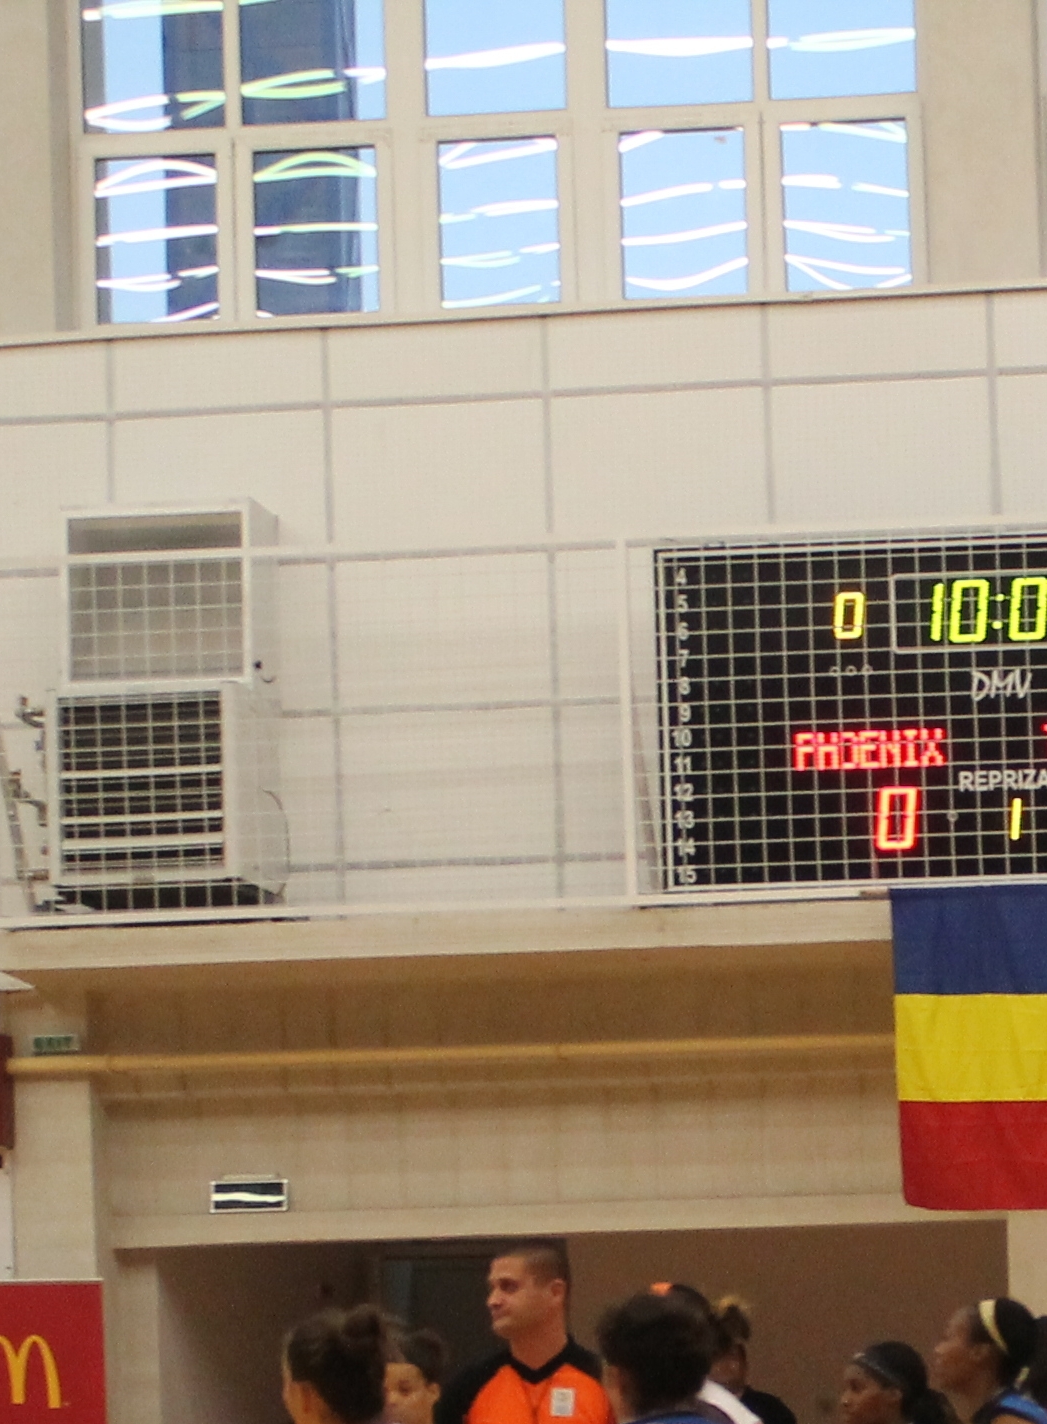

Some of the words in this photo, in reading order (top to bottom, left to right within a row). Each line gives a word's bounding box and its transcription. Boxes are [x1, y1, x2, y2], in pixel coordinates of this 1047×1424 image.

[676, 567, 687, 585] 4
[677, 593, 688, 613] 5
[833, 591, 865, 640] 0
[677, 621, 689, 641] 6
[678, 649, 689, 668] 7
[679, 676, 691, 695] 8
[970, 667, 1032, 701] DMV
[680, 703, 691, 722] 9
[672, 729, 692, 747] 10
[674, 755, 692, 773] 11
[674, 782, 694, 802] 12
[876, 786, 920, 850] 0
[1009, 797, 1022, 840] 1
